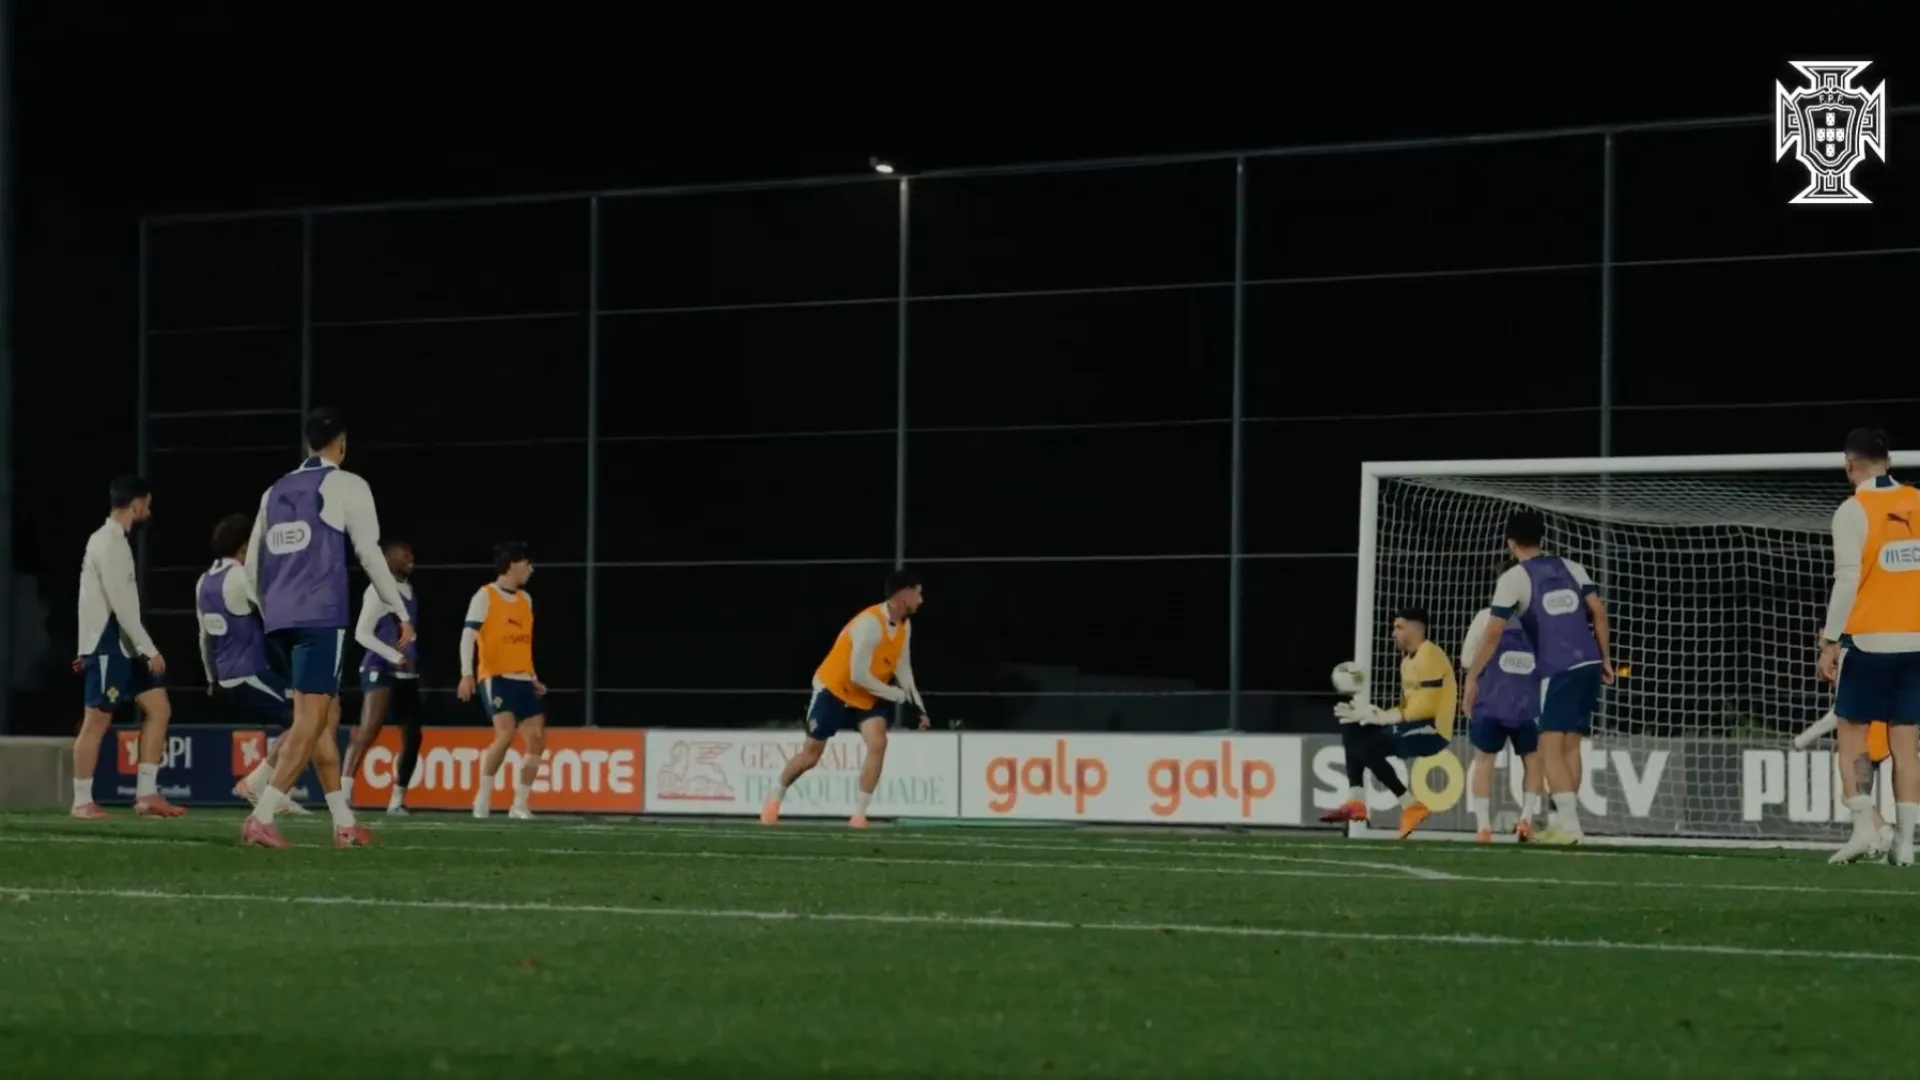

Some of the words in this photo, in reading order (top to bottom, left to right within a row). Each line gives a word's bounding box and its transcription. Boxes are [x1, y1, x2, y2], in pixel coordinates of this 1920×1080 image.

[363, 746, 634, 793] CONTNENTE
[740, 741, 864, 771] GENALI
[986, 739, 1108, 814] galp
[1147, 740, 1276, 817] galp
[740, 774, 944, 807] TRNQUILDADE
[1743, 750, 1920, 823] PU
